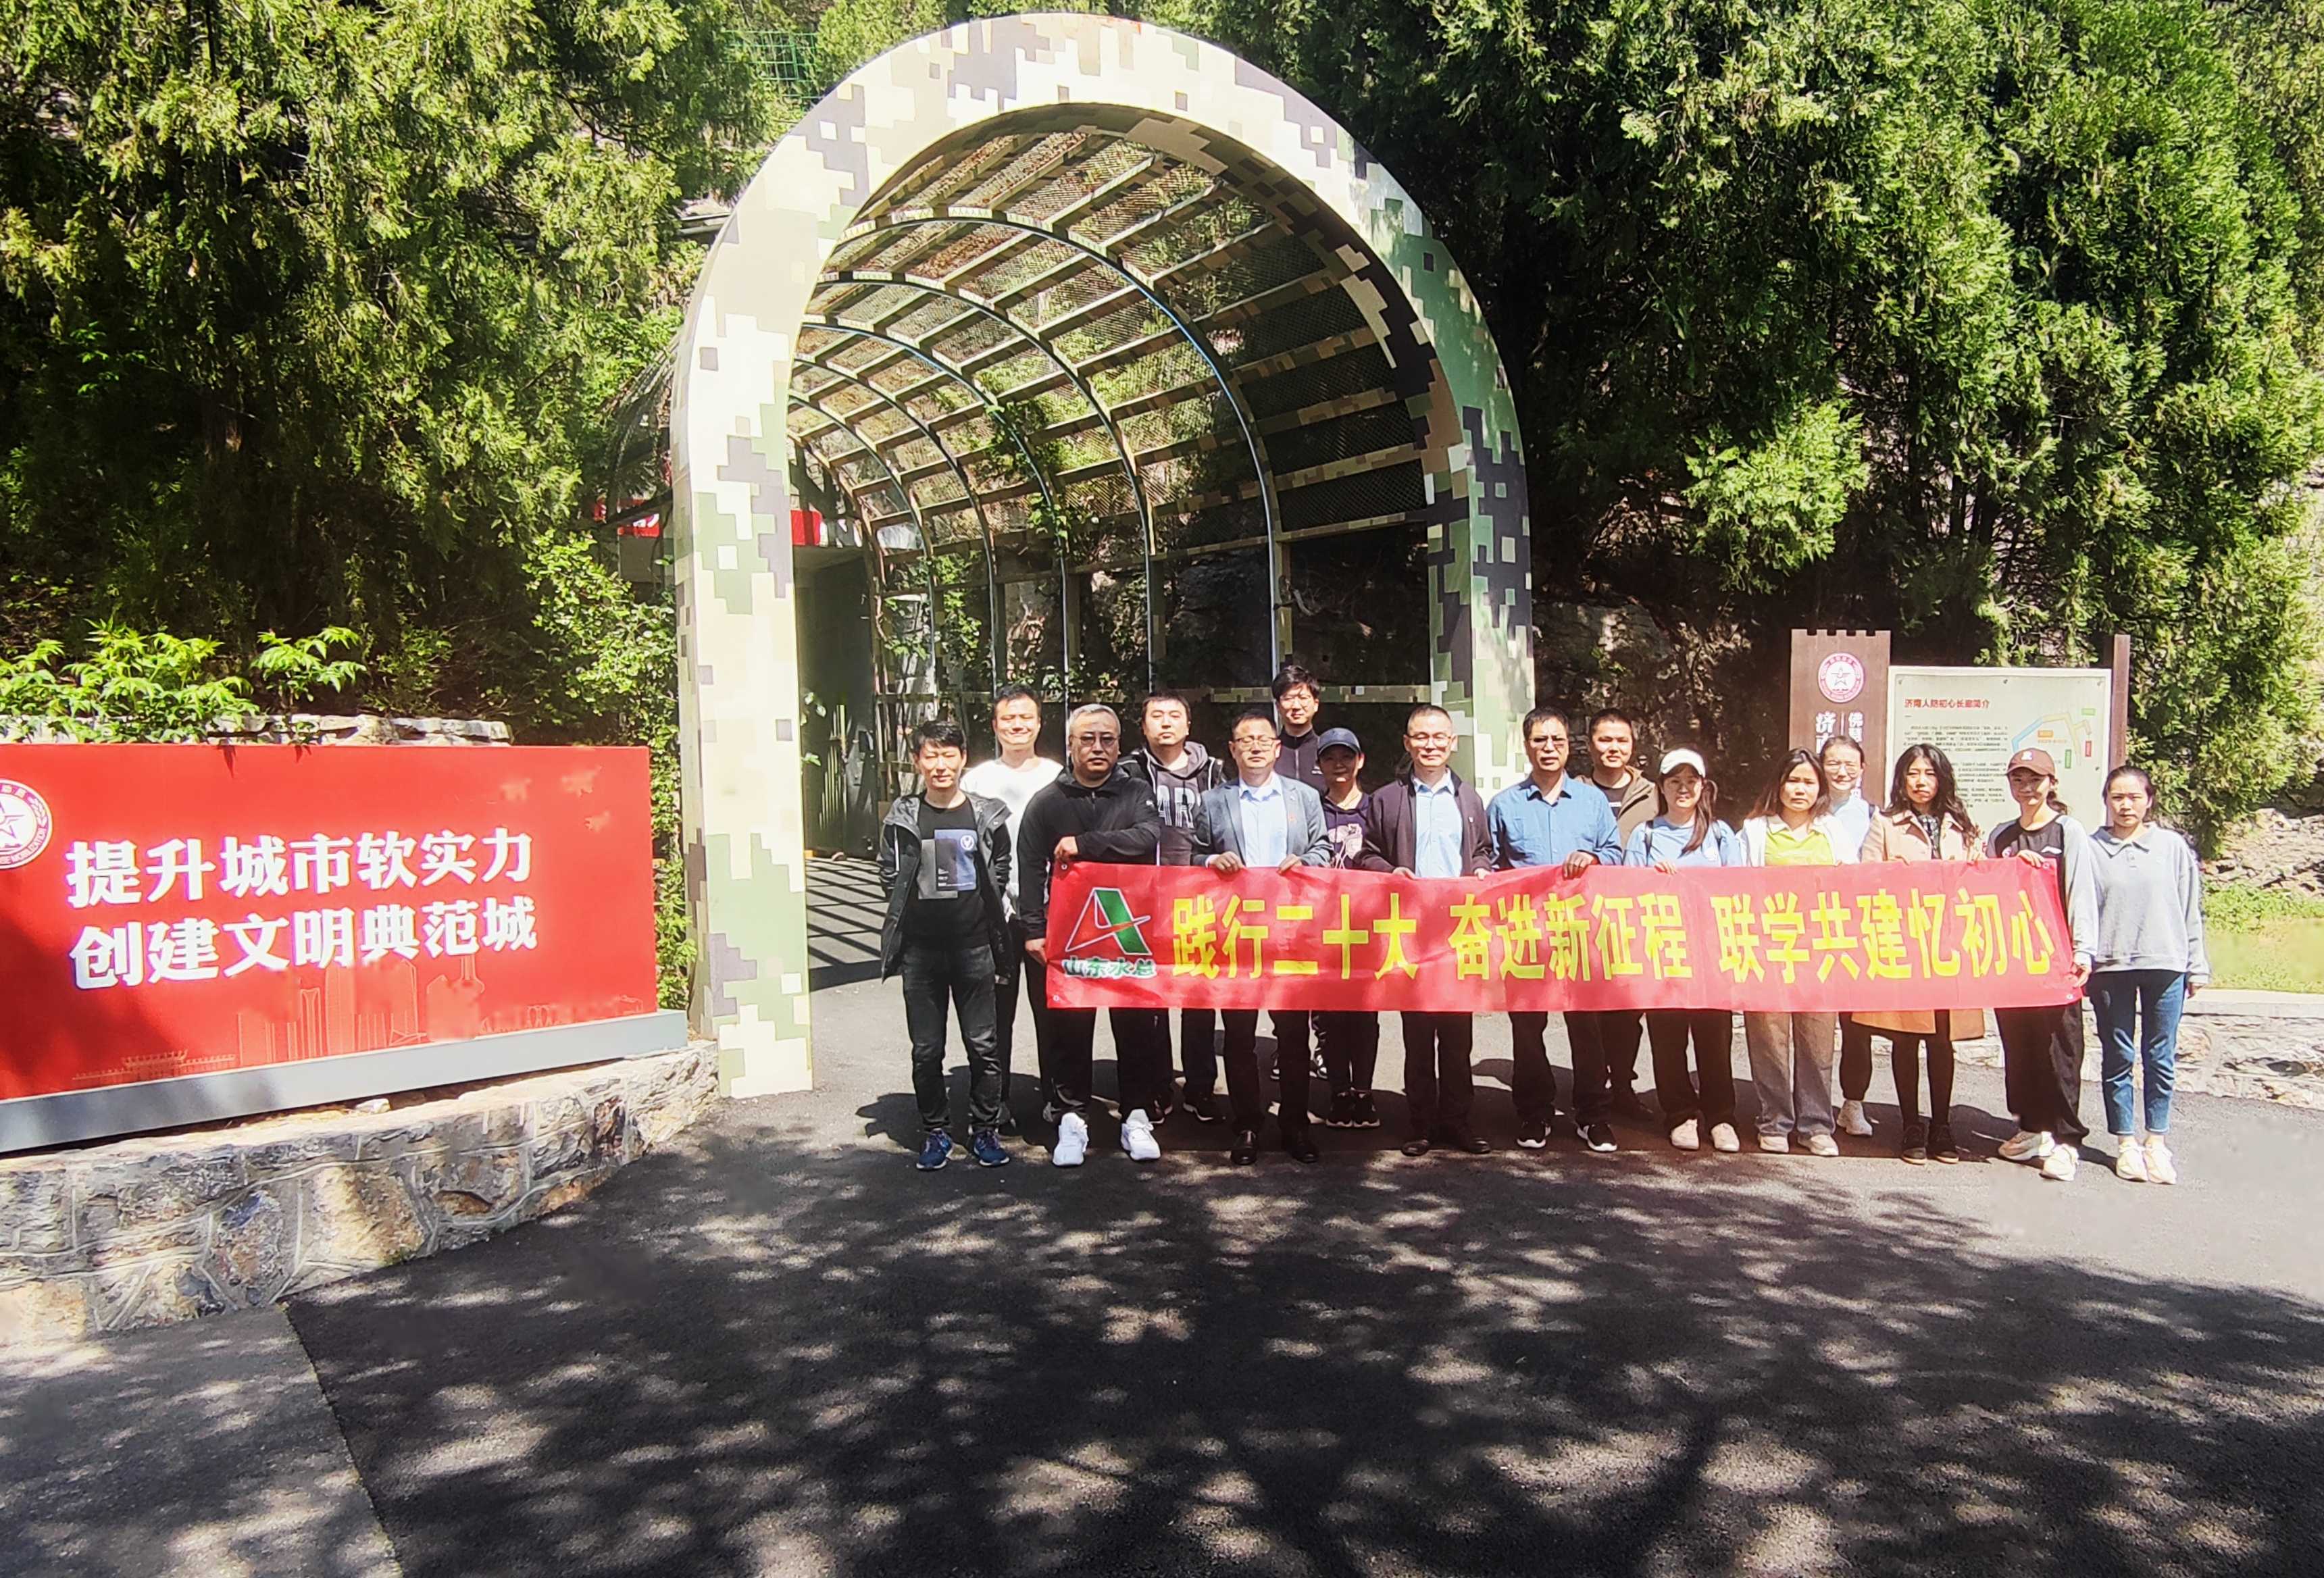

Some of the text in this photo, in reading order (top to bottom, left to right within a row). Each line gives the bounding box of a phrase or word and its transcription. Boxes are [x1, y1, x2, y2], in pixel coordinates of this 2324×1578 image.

[66, 828, 532, 909] 提升城市软实力
[69, 896, 538, 990] 创建文明典范城
[1173, 890, 2056, 984] 践行二十大 奋进新征程 联学共建忆初心
